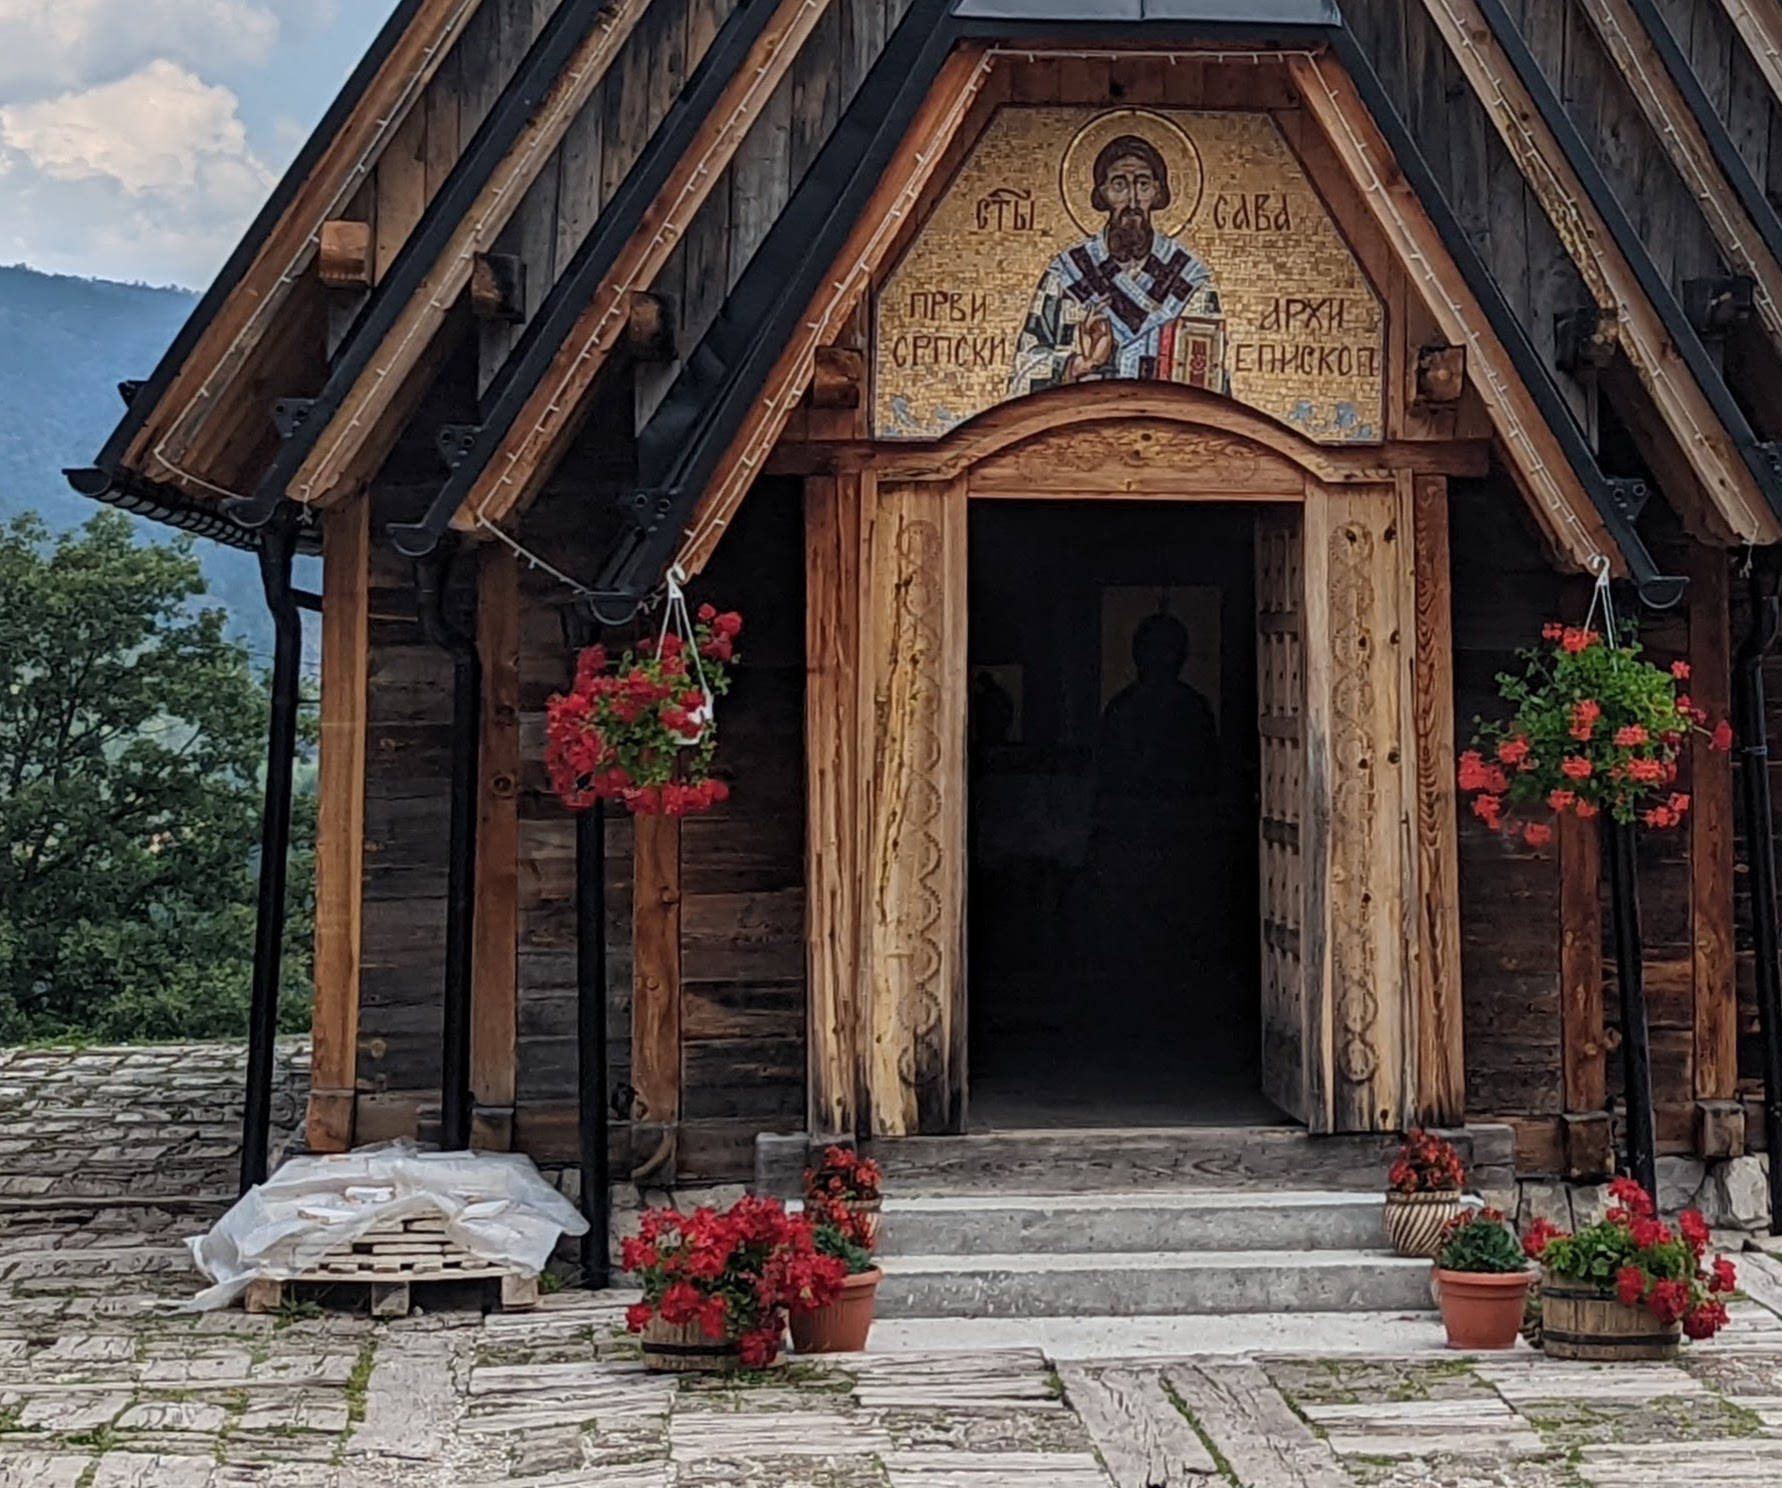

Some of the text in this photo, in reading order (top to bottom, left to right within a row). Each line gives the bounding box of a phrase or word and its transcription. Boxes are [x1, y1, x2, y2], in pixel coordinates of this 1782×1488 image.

[1214, 193, 1291, 231] САВА
[909, 290, 987, 321] ПРВИ
[1259, 298, 1345, 331] АРХИ
[892, 334, 1006, 368] СРПСКИ
[1235, 344, 1376, 377] ЕПИСКОП
